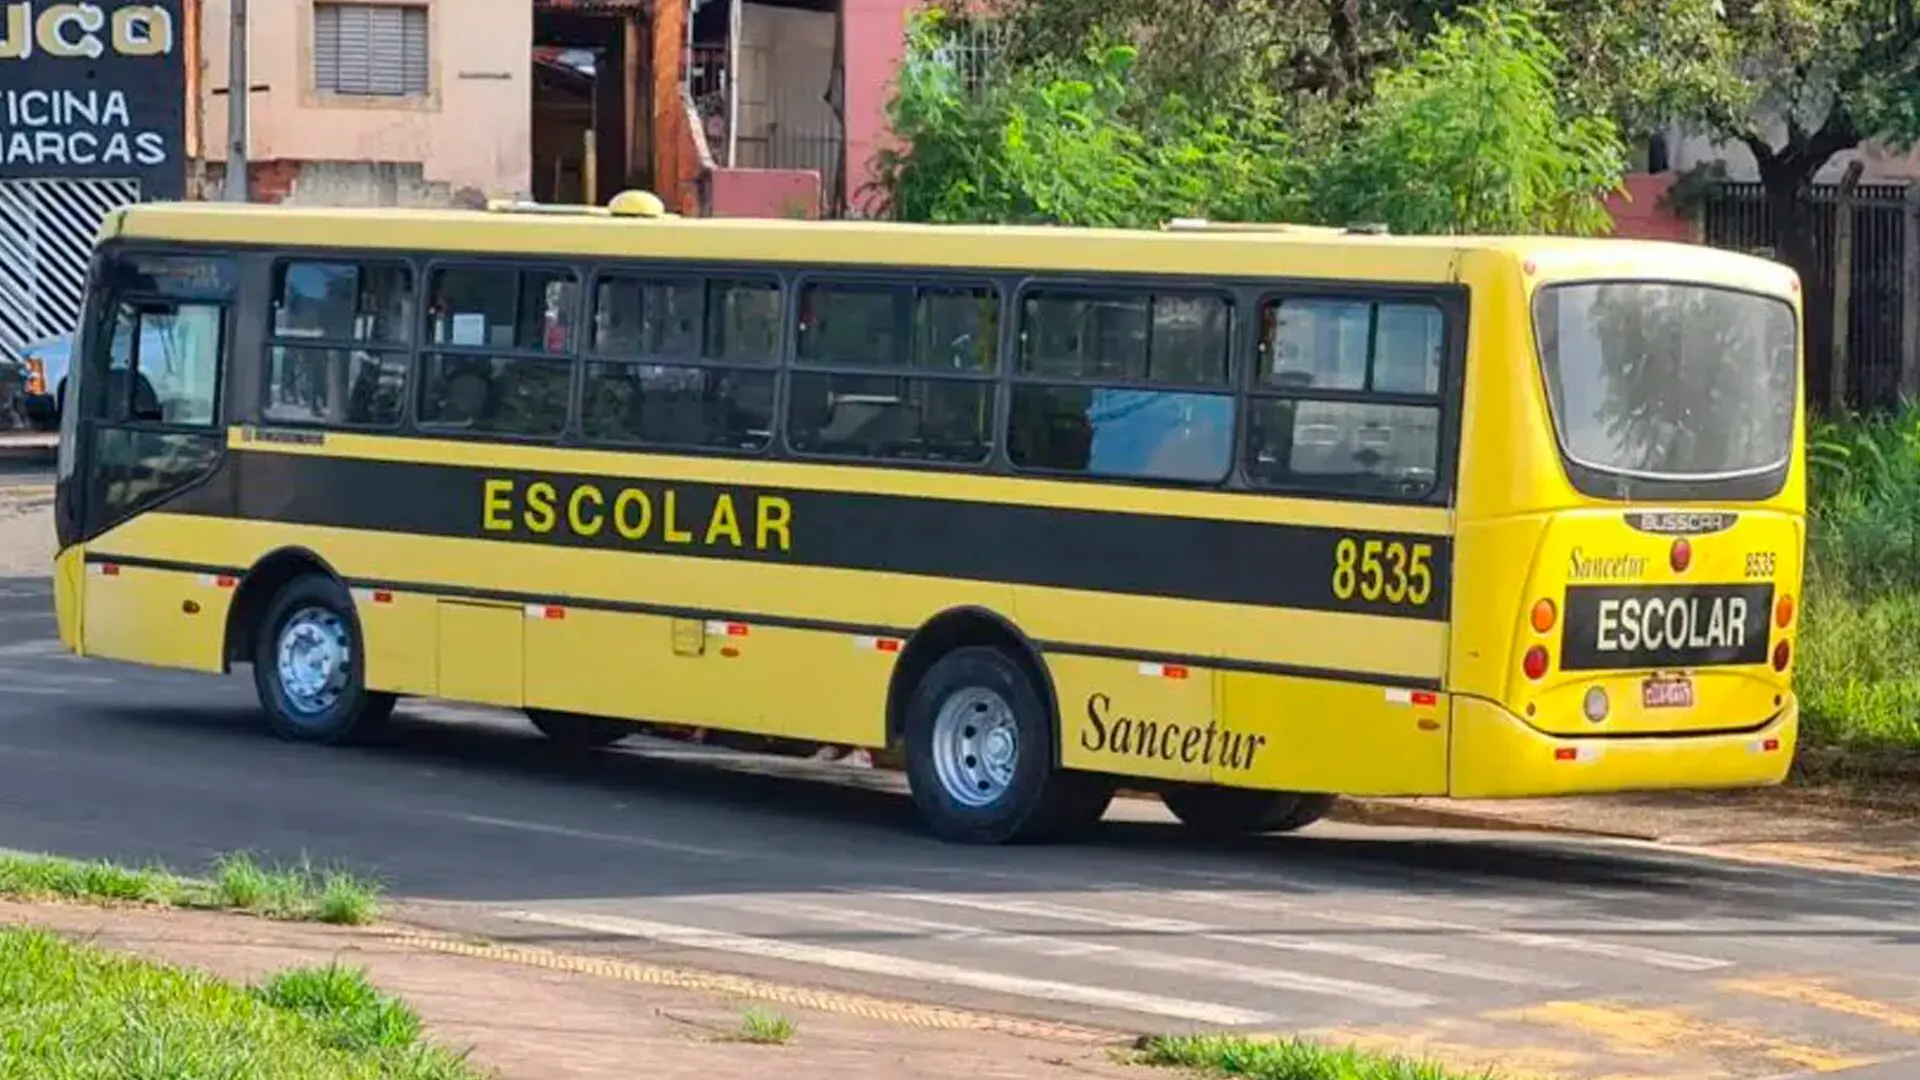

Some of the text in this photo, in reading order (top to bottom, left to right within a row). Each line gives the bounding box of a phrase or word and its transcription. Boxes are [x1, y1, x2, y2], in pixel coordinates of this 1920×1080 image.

[0, 89, 130, 126] ICINA
[0, 131, 166, 164] ARCAS
[483, 479, 793, 550] ESCOLAR
[1333, 537, 1433, 605] 8535
[1568, 546, 1649, 578] Sancetur
[1744, 551, 1776, 577] 8535
[1596, 597, 1747, 650] ESCOLAR
[1081, 692, 1266, 770] Sancetur
